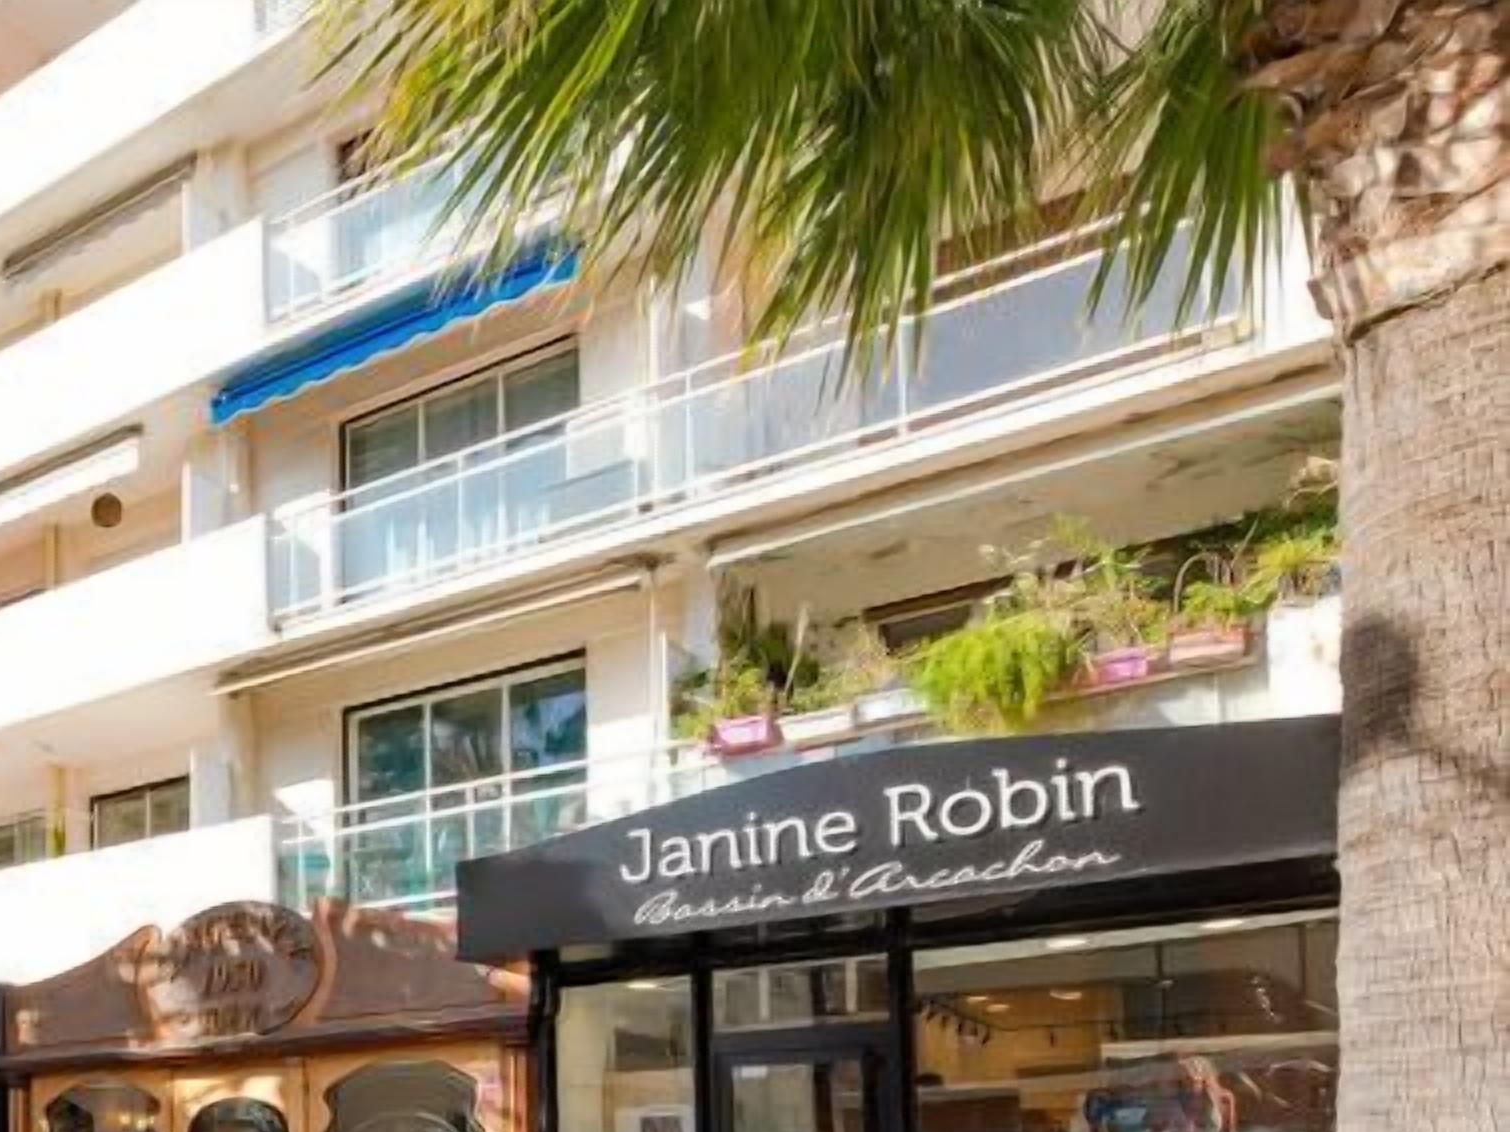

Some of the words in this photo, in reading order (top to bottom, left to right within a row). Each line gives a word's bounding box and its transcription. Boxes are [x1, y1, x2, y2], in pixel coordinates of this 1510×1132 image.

[619, 811, 858, 883] Janine
[883, 757, 1140, 847] Robin
[633, 884, 793, 925] Bassin
[801, 839, 1122, 904] d'Arcachon
